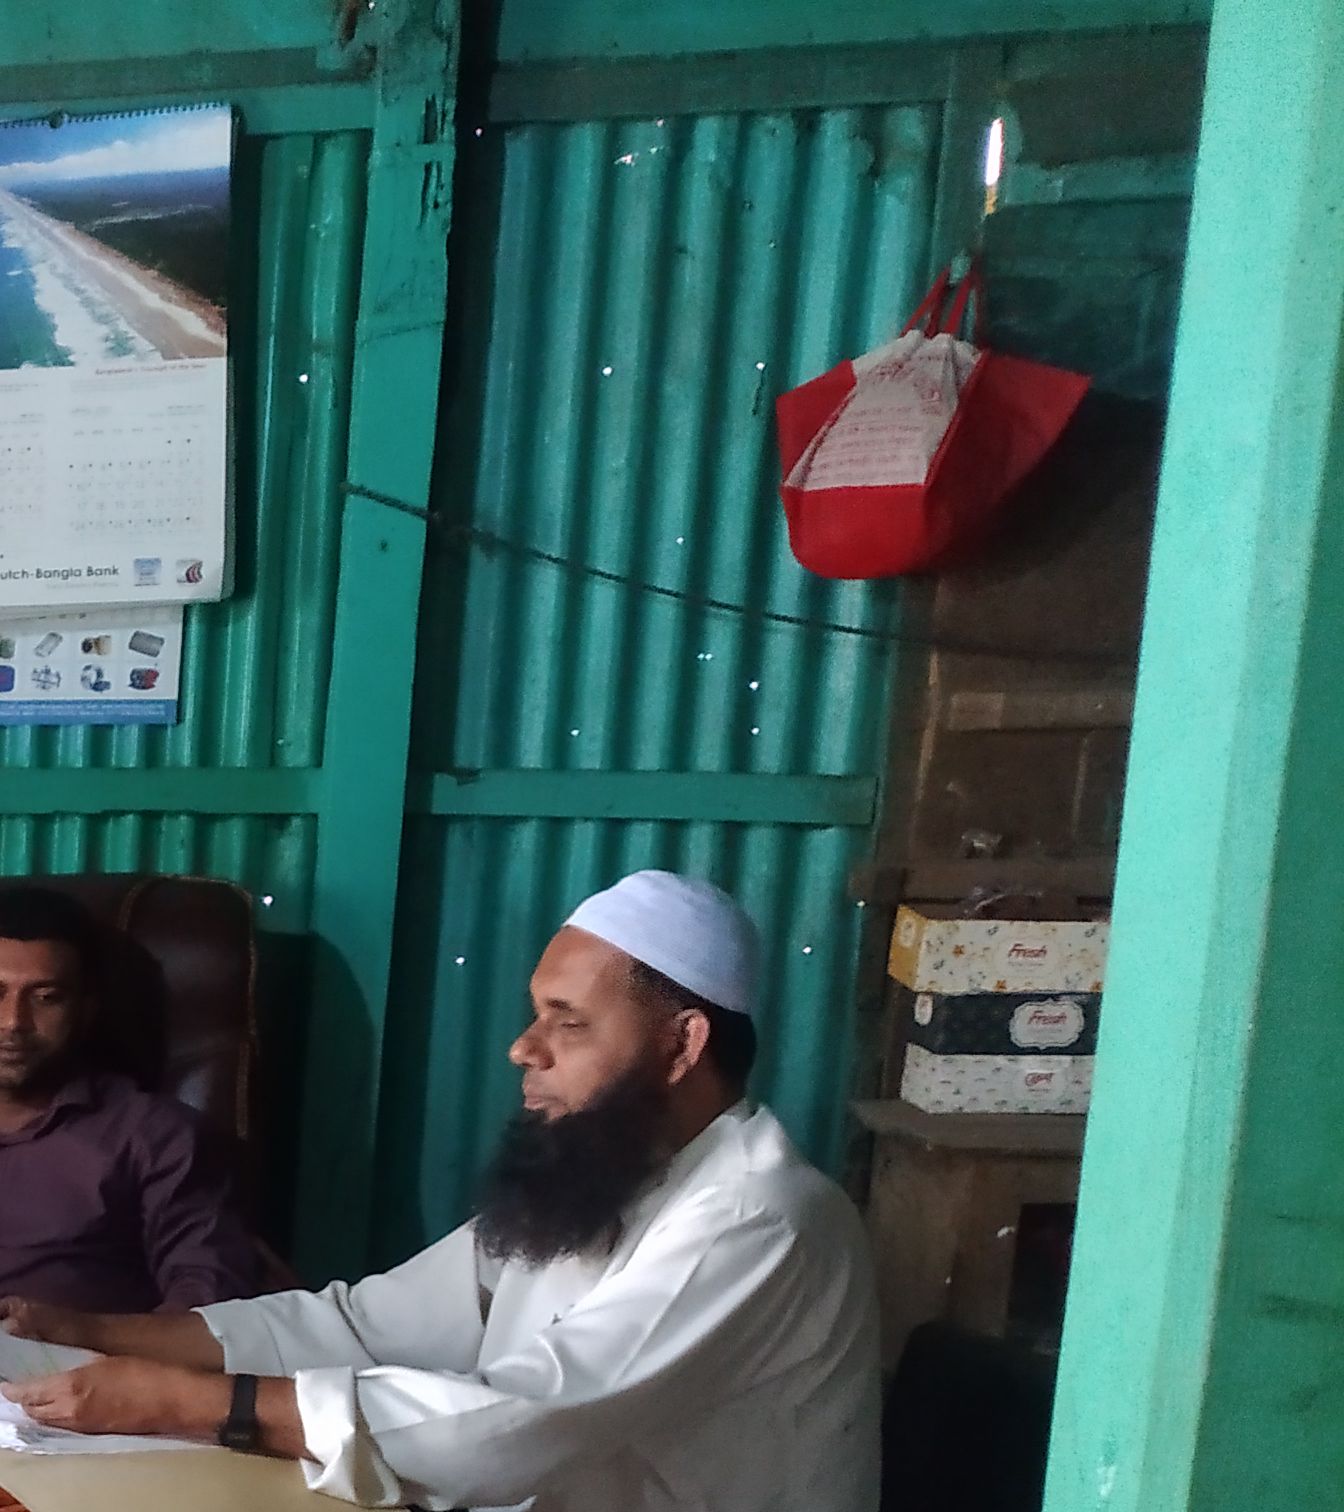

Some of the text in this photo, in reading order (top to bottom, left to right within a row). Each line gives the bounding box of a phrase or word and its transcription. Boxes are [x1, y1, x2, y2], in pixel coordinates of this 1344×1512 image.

[86, 565, 120, 577] Bank
[1007, 943, 1047, 959] Fresh
[1027, 1010, 1067, 1025] Fresh
